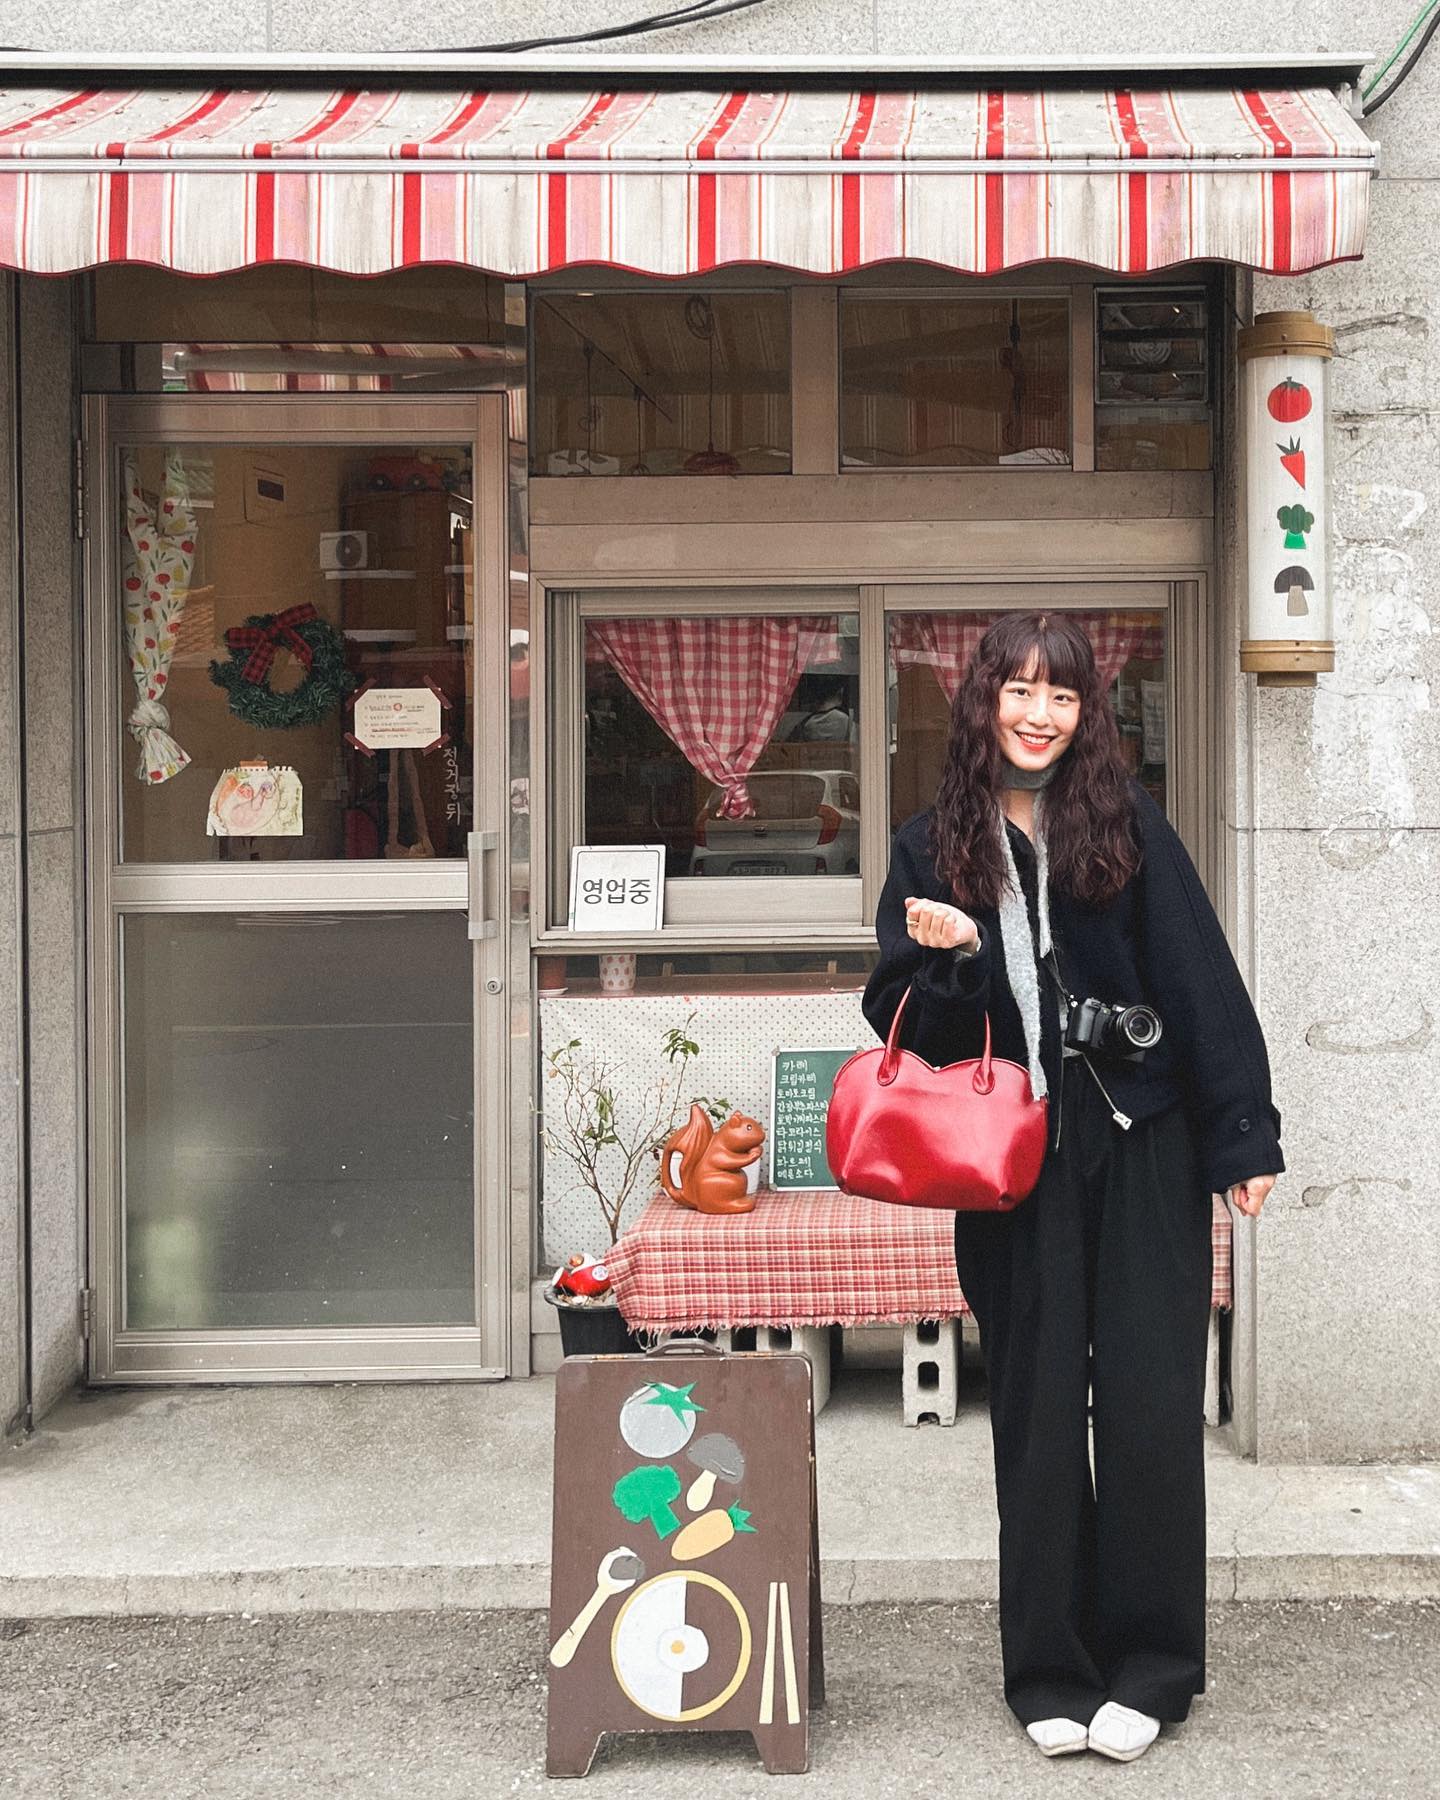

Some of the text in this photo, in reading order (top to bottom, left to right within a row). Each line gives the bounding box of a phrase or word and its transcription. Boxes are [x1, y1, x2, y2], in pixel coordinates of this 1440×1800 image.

[583, 878, 652, 905] 영업중
[782, 1059, 808, 1072] 카레
[780, 1072, 817, 1086] 크림카레
[777, 1087, 816, 1100] 토마토크림
[776, 1126, 822, 1139] 타코라이스
[777, 1139, 822, 1154] 닭튀김정식
